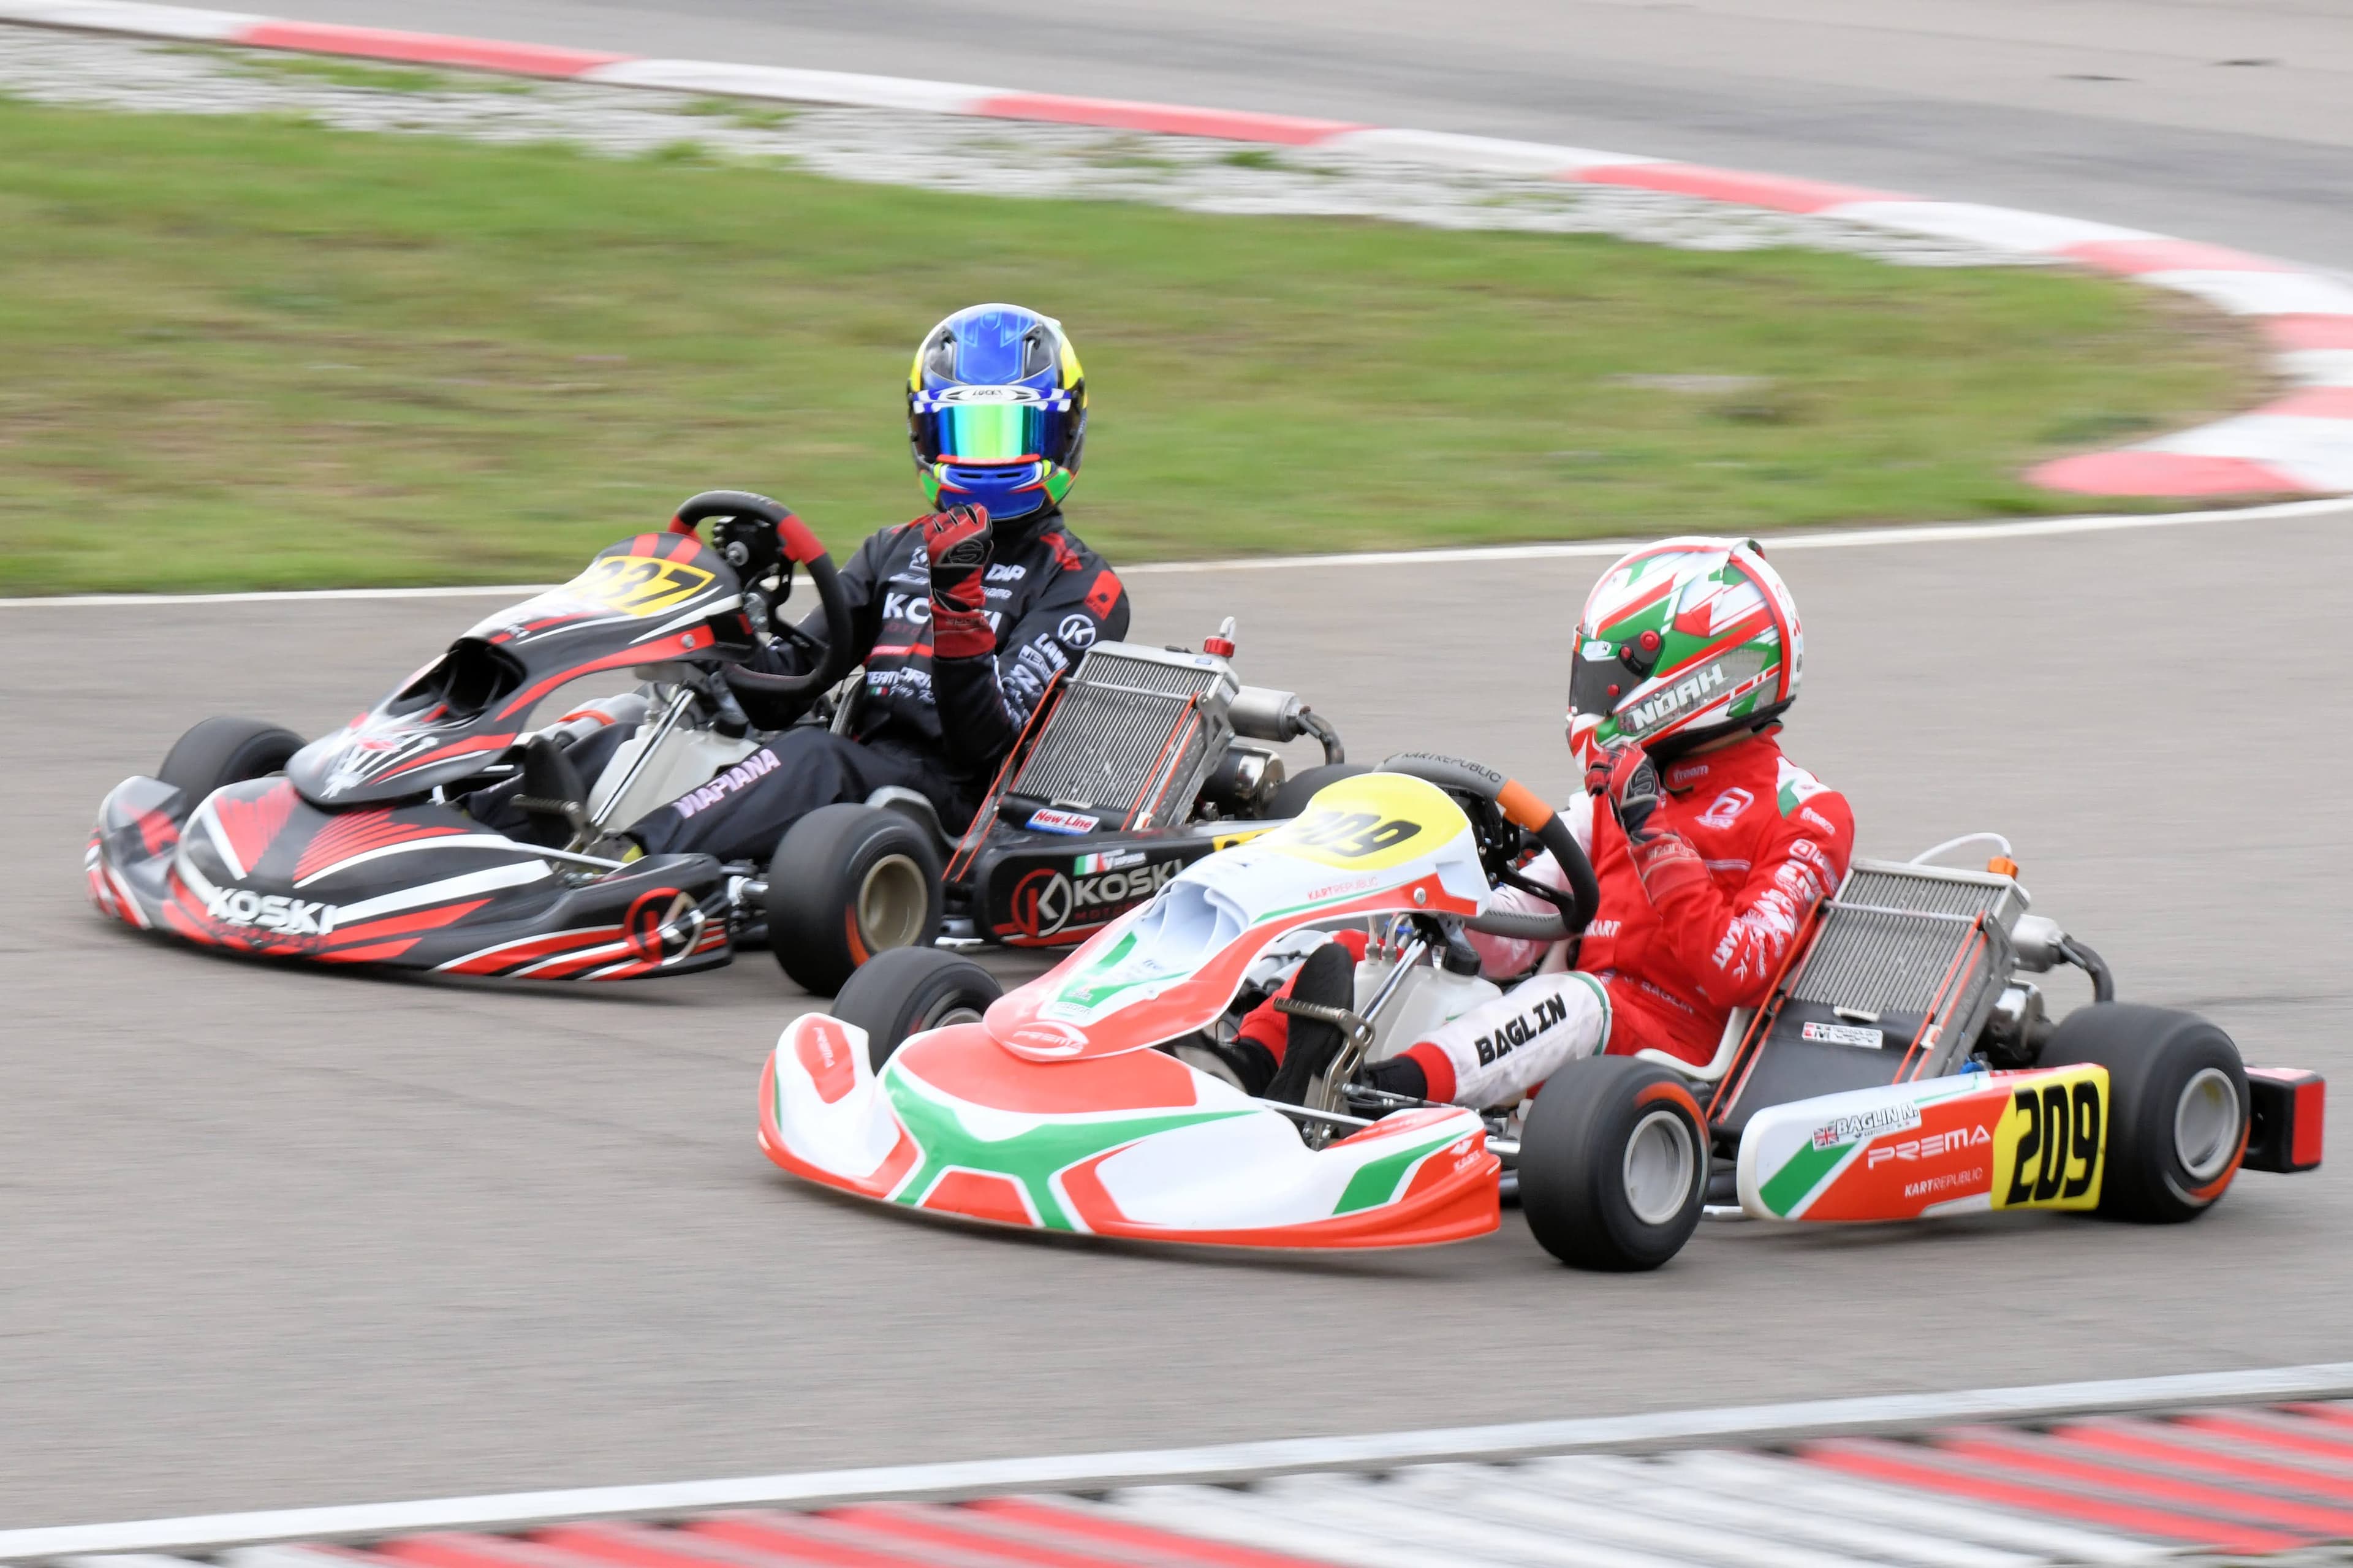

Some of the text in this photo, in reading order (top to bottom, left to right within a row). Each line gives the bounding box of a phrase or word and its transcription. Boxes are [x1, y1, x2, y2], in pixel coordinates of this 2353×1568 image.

[866, 670, 900, 686] TEAM
[1627, 663, 1727, 730] NOAH
[672, 748, 781, 819] VIAPIANA
[1074, 858, 1183, 907] KOSKI
[1307, 877, 1379, 901] KARTREPUBLIC
[206, 886, 338, 936] KOSKI
[1474, 991, 1567, 1067] BAGLIN
[1836, 1106, 1900, 1134] BAGLIN
[2005, 1080, 2101, 1205] 209
[1868, 1124, 1992, 1170] PREMA
[1904, 1167, 1983, 1198] KARTREPUBLIC
